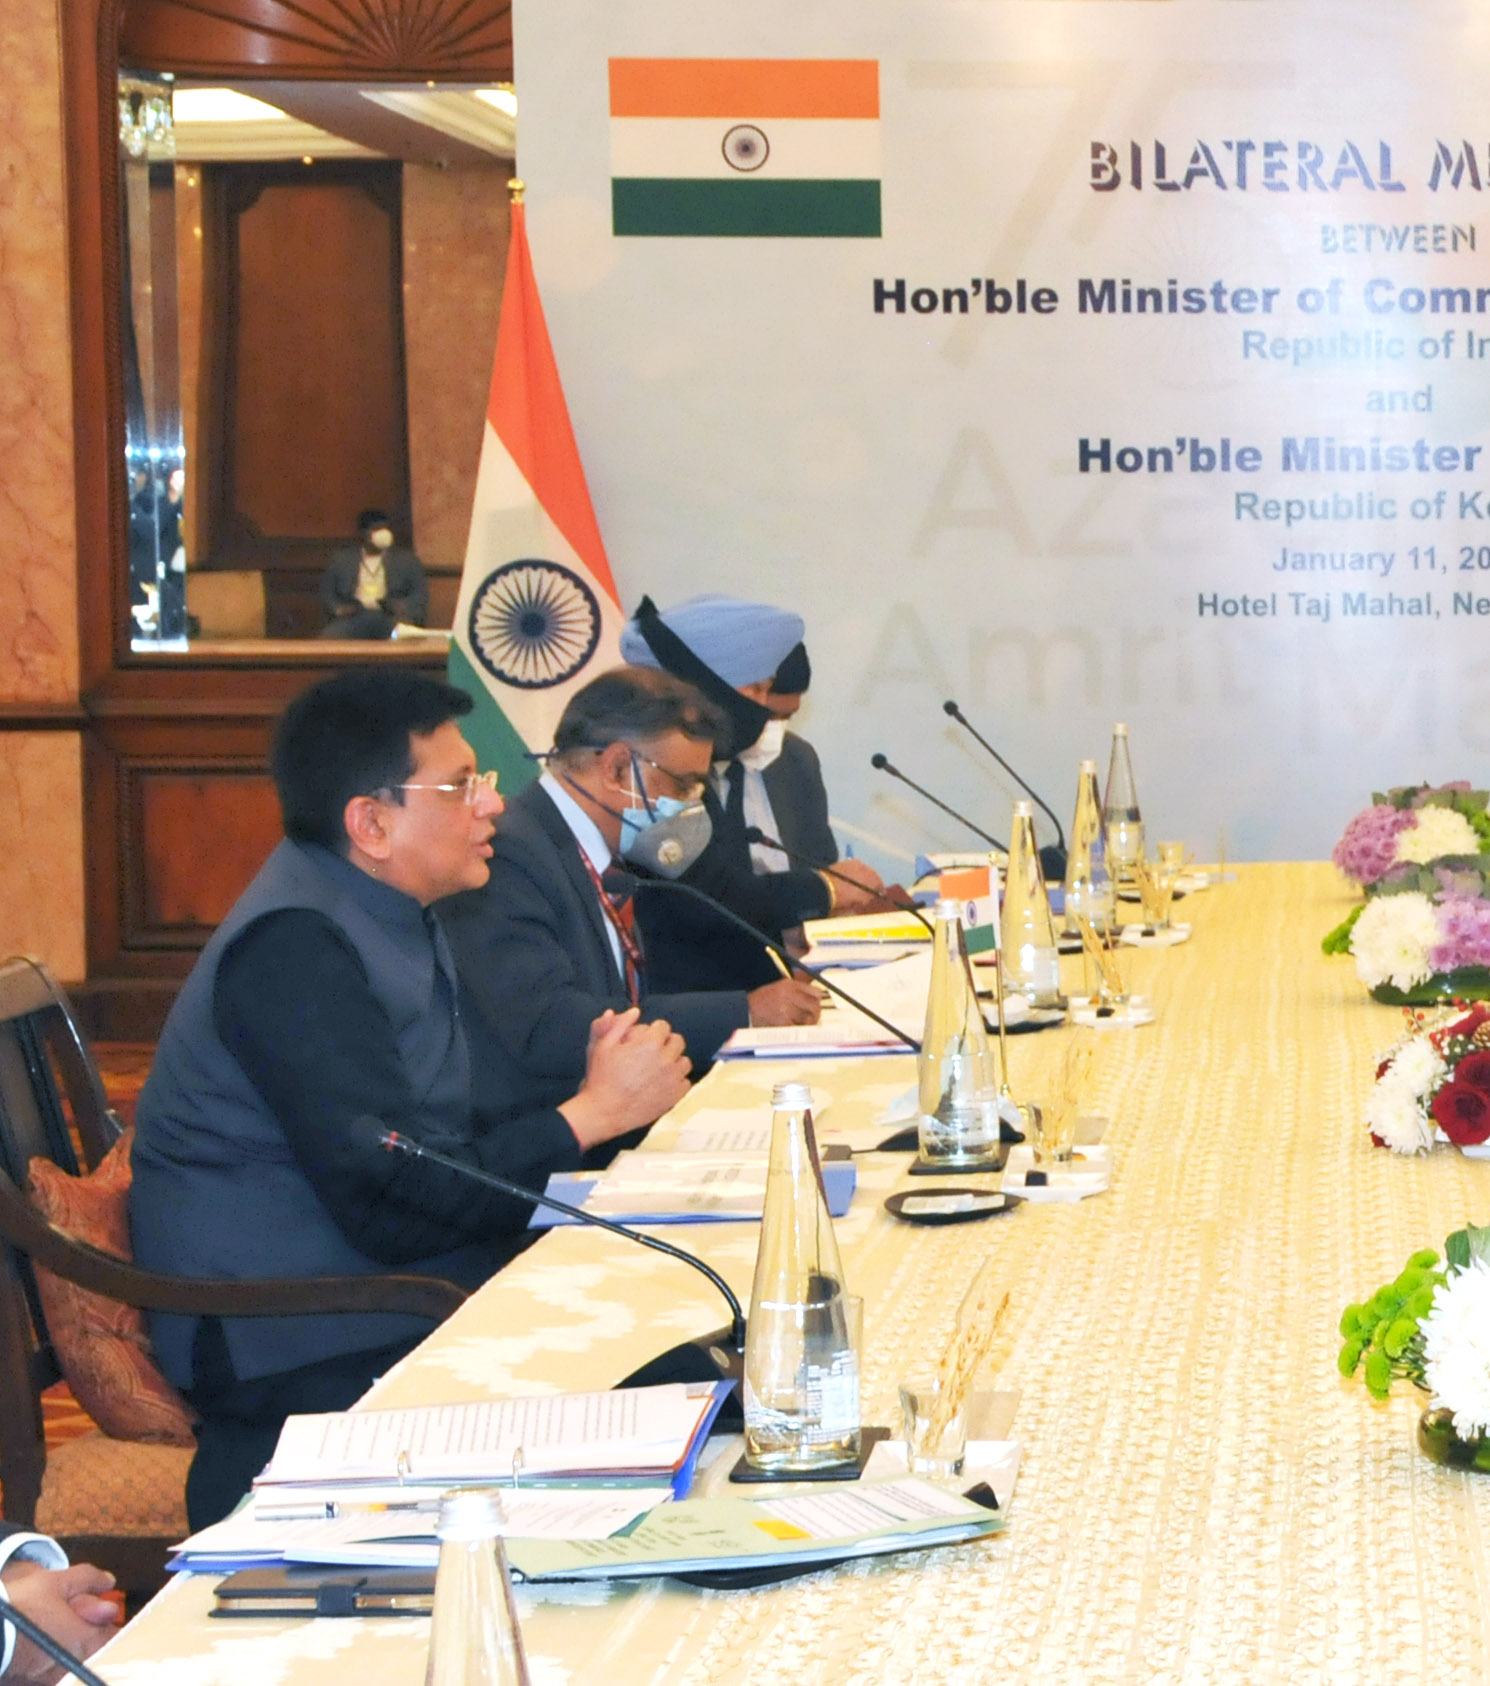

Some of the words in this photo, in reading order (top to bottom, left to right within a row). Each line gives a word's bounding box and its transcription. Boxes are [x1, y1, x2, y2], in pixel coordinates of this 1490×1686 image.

[1088, 137, 1407, 194] BILATERAL
[1320, 223, 1478, 255] BETWEEN
[1077, 277, 1282, 316] Minister
[1296, 278, 1347, 315] of
[1241, 329, 1405, 368] Republic
[1416, 329, 1457, 361] of
[1364, 382, 1434, 414] and
[1281, 436, 1483, 474] Minister
[1234, 490, 1399, 530] Republic
[1408, 490, 1448, 521] of
[1271, 545, 1397, 578] January
[1406, 544, 1448, 575] 11,
[1197, 590, 1278, 619] Hotel
[1287, 590, 1331, 624] Taj
[1341, 590, 1442, 621] Mahal,
